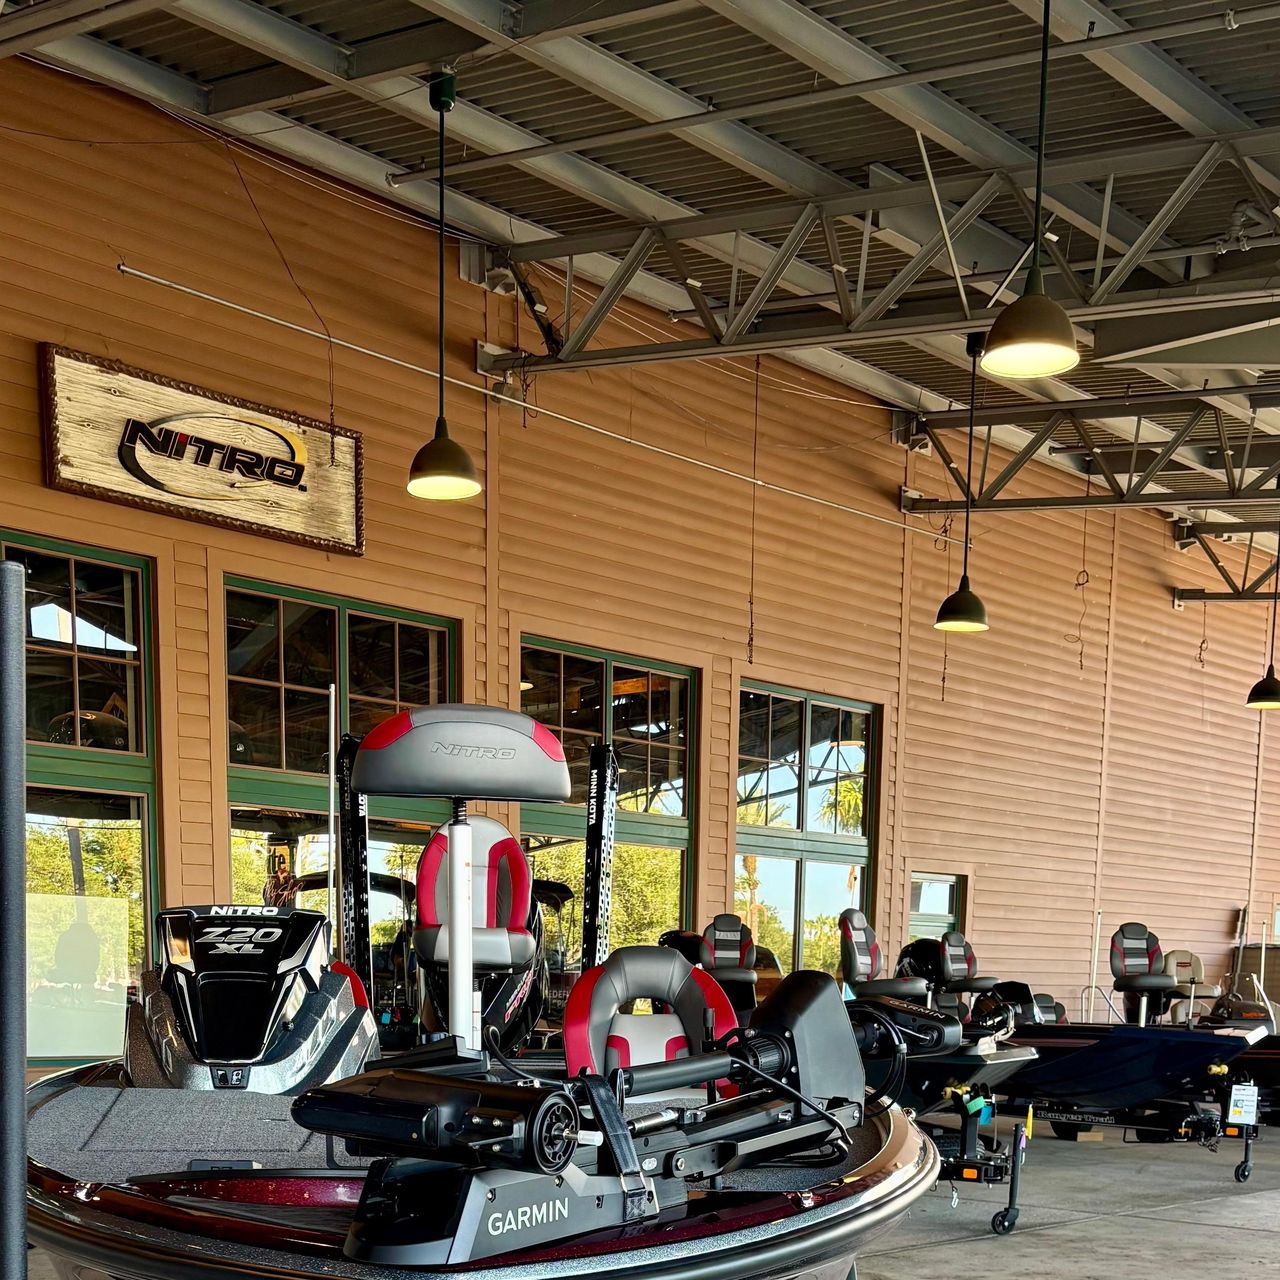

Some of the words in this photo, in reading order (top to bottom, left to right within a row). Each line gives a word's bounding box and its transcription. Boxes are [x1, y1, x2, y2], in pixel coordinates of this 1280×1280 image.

[589, 769, 598, 797] MINN
[588, 798, 597, 826] KOTA
[195, 927, 283, 943] Z20
[208, 943, 265, 954] XL
[889, 1000, 947, 1019] GARMIN
[487, 1197, 569, 1236] GARMIN
